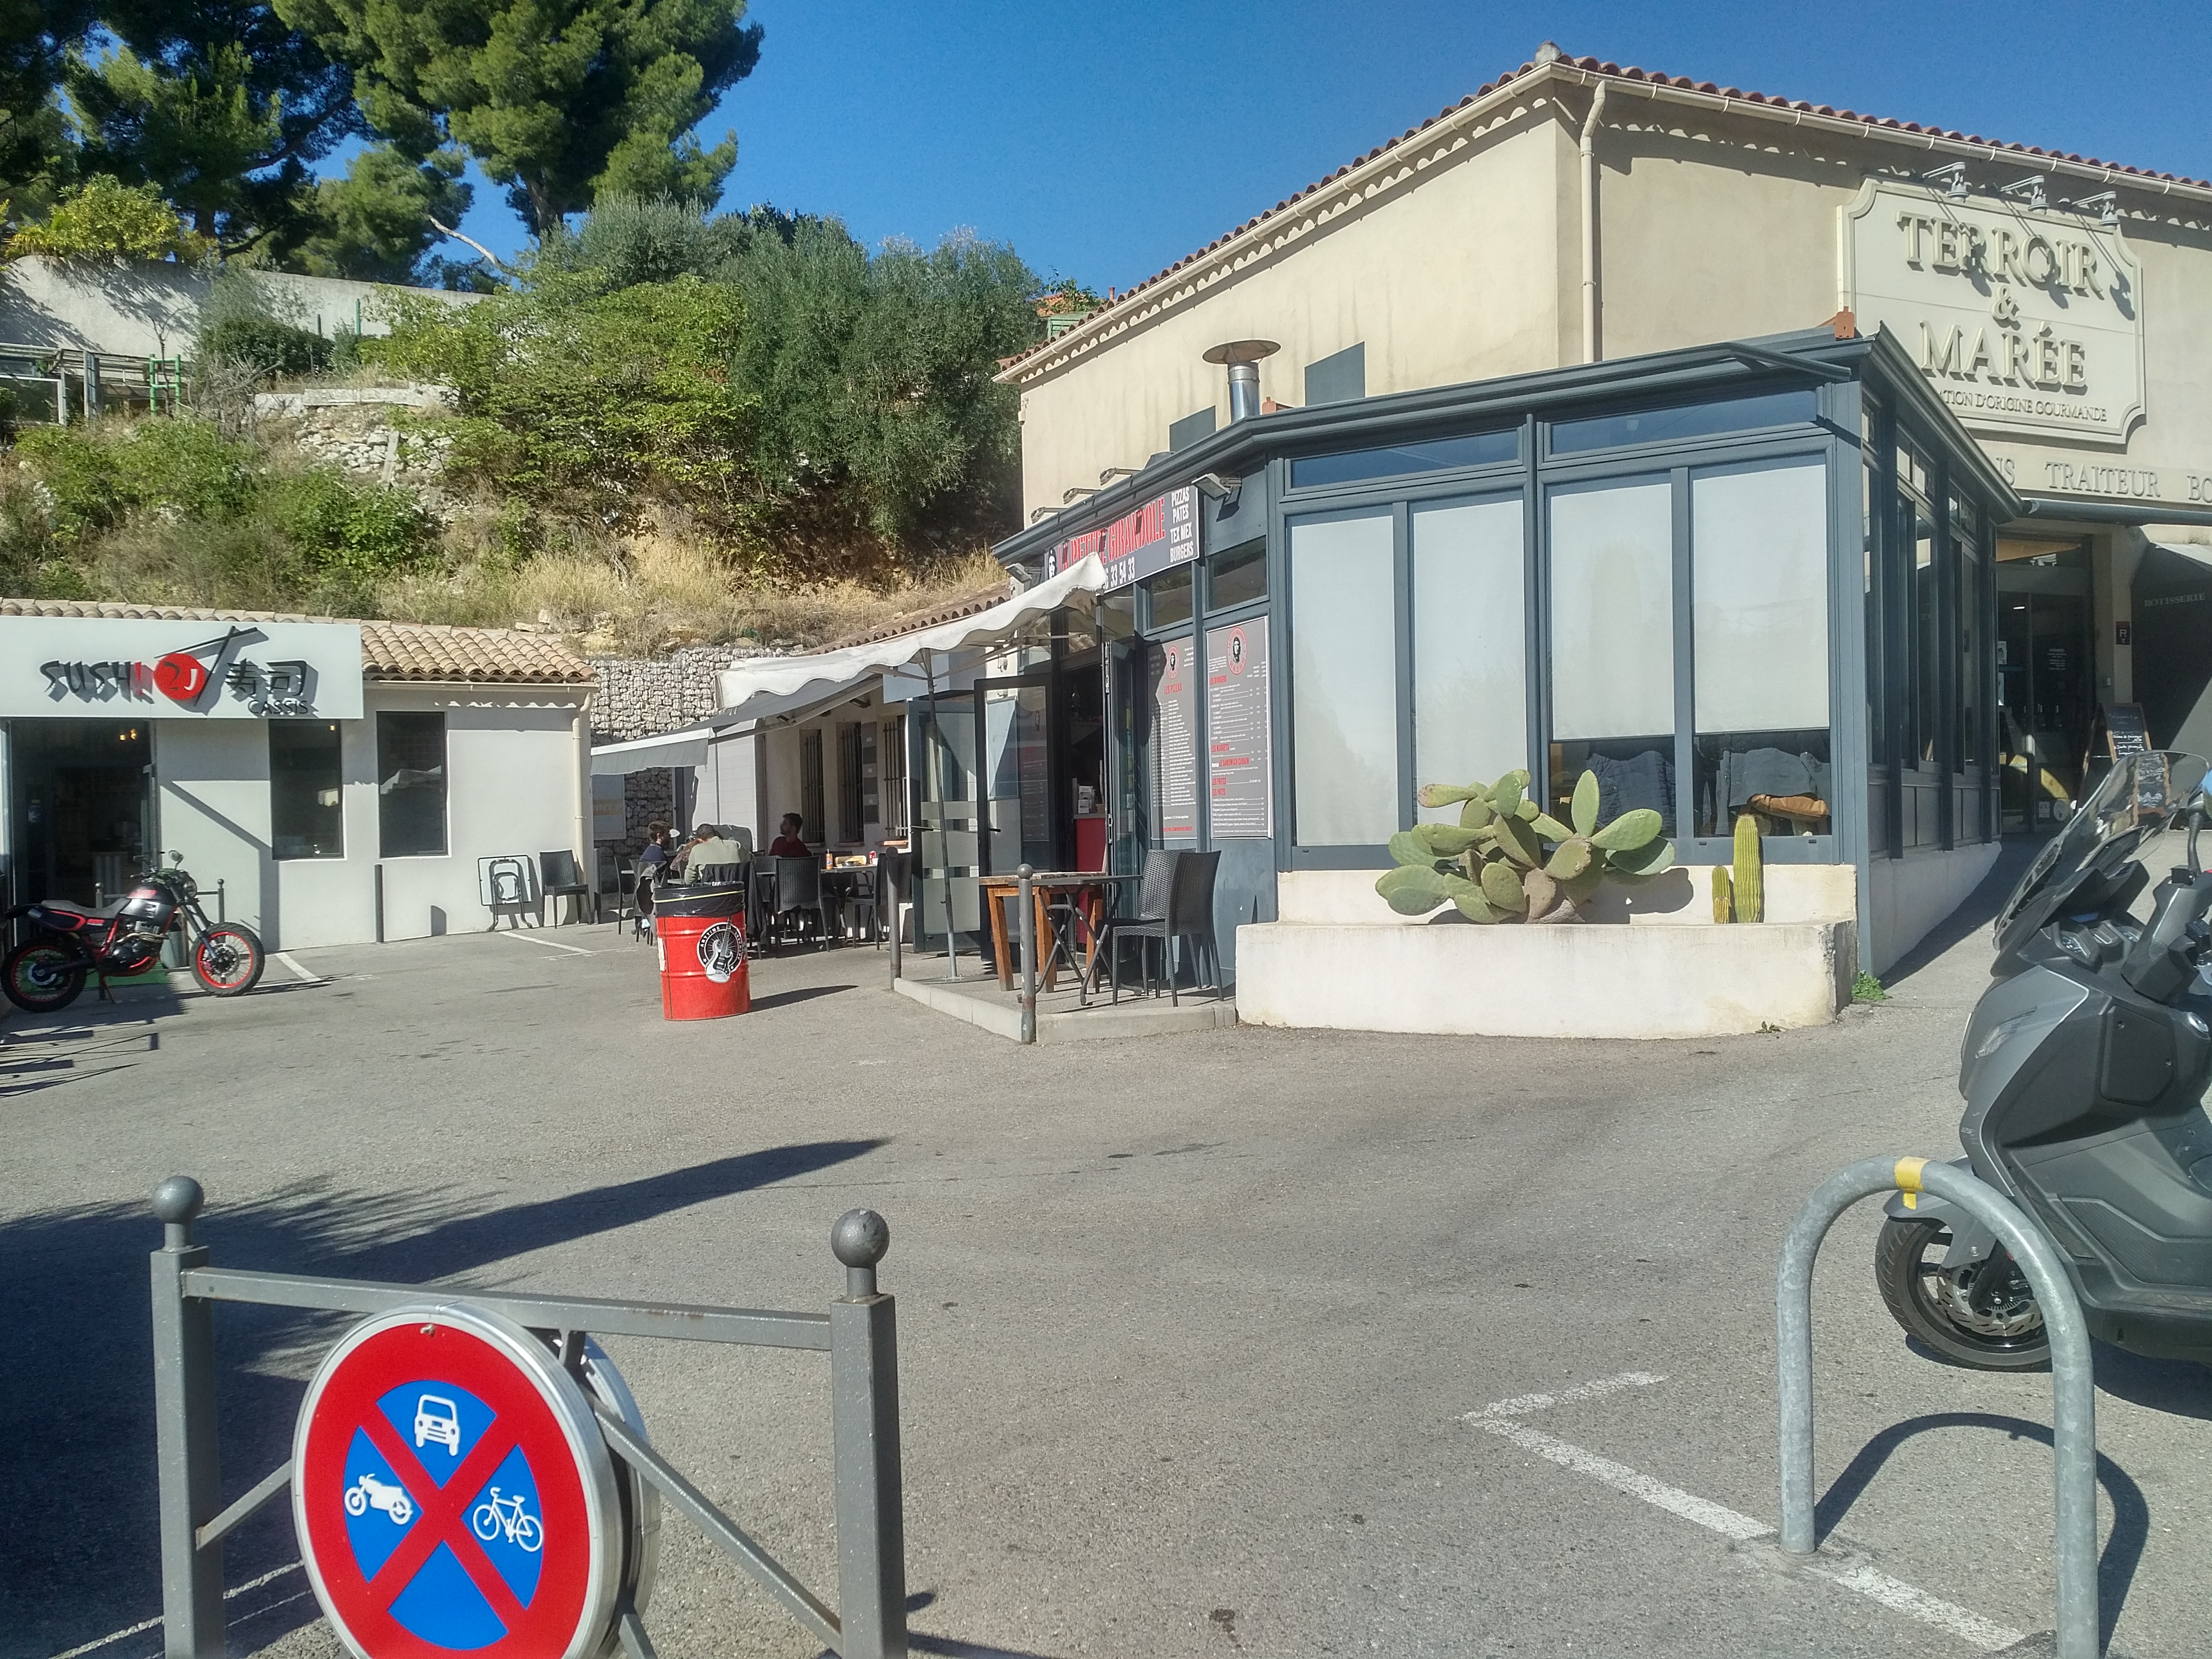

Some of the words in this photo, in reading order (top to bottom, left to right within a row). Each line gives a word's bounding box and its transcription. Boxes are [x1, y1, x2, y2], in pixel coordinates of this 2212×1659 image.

[1897, 211, 2103, 294] TERROIR
[1992, 285, 2019, 321] &
[1919, 320, 2086, 387] MARÉE
[1975, 393, 2033, 413] D'ORIGINE
[2036, 401, 2107, 422] GOURMANDE
[2045, 461, 2161, 497] TRAITEUR
[1171, 487, 1189, 507] PIZZAS
[1172, 503, 1189, 524] PATES
[1070, 528, 1106, 566] PETITE
[1108, 497, 1166, 562] GIRANDOLE
[1170, 526, 1180, 544] TEX
[1180, 521, 1192, 541] MEX
[1170, 540, 1194, 563] BURGERS
[1111, 565, 1118, 587] 33
[1119, 560, 1126, 584] 54
[1128, 556, 1135, 581] 33
[2145, 593, 2205, 607] ROTISSERIE
[225, 658, 307, 697] 寿司
[1170, 682, 1182, 694] PIZZAS
[248, 700, 308, 714] CASSIS
[700, 926, 720, 947] ANYTIME
